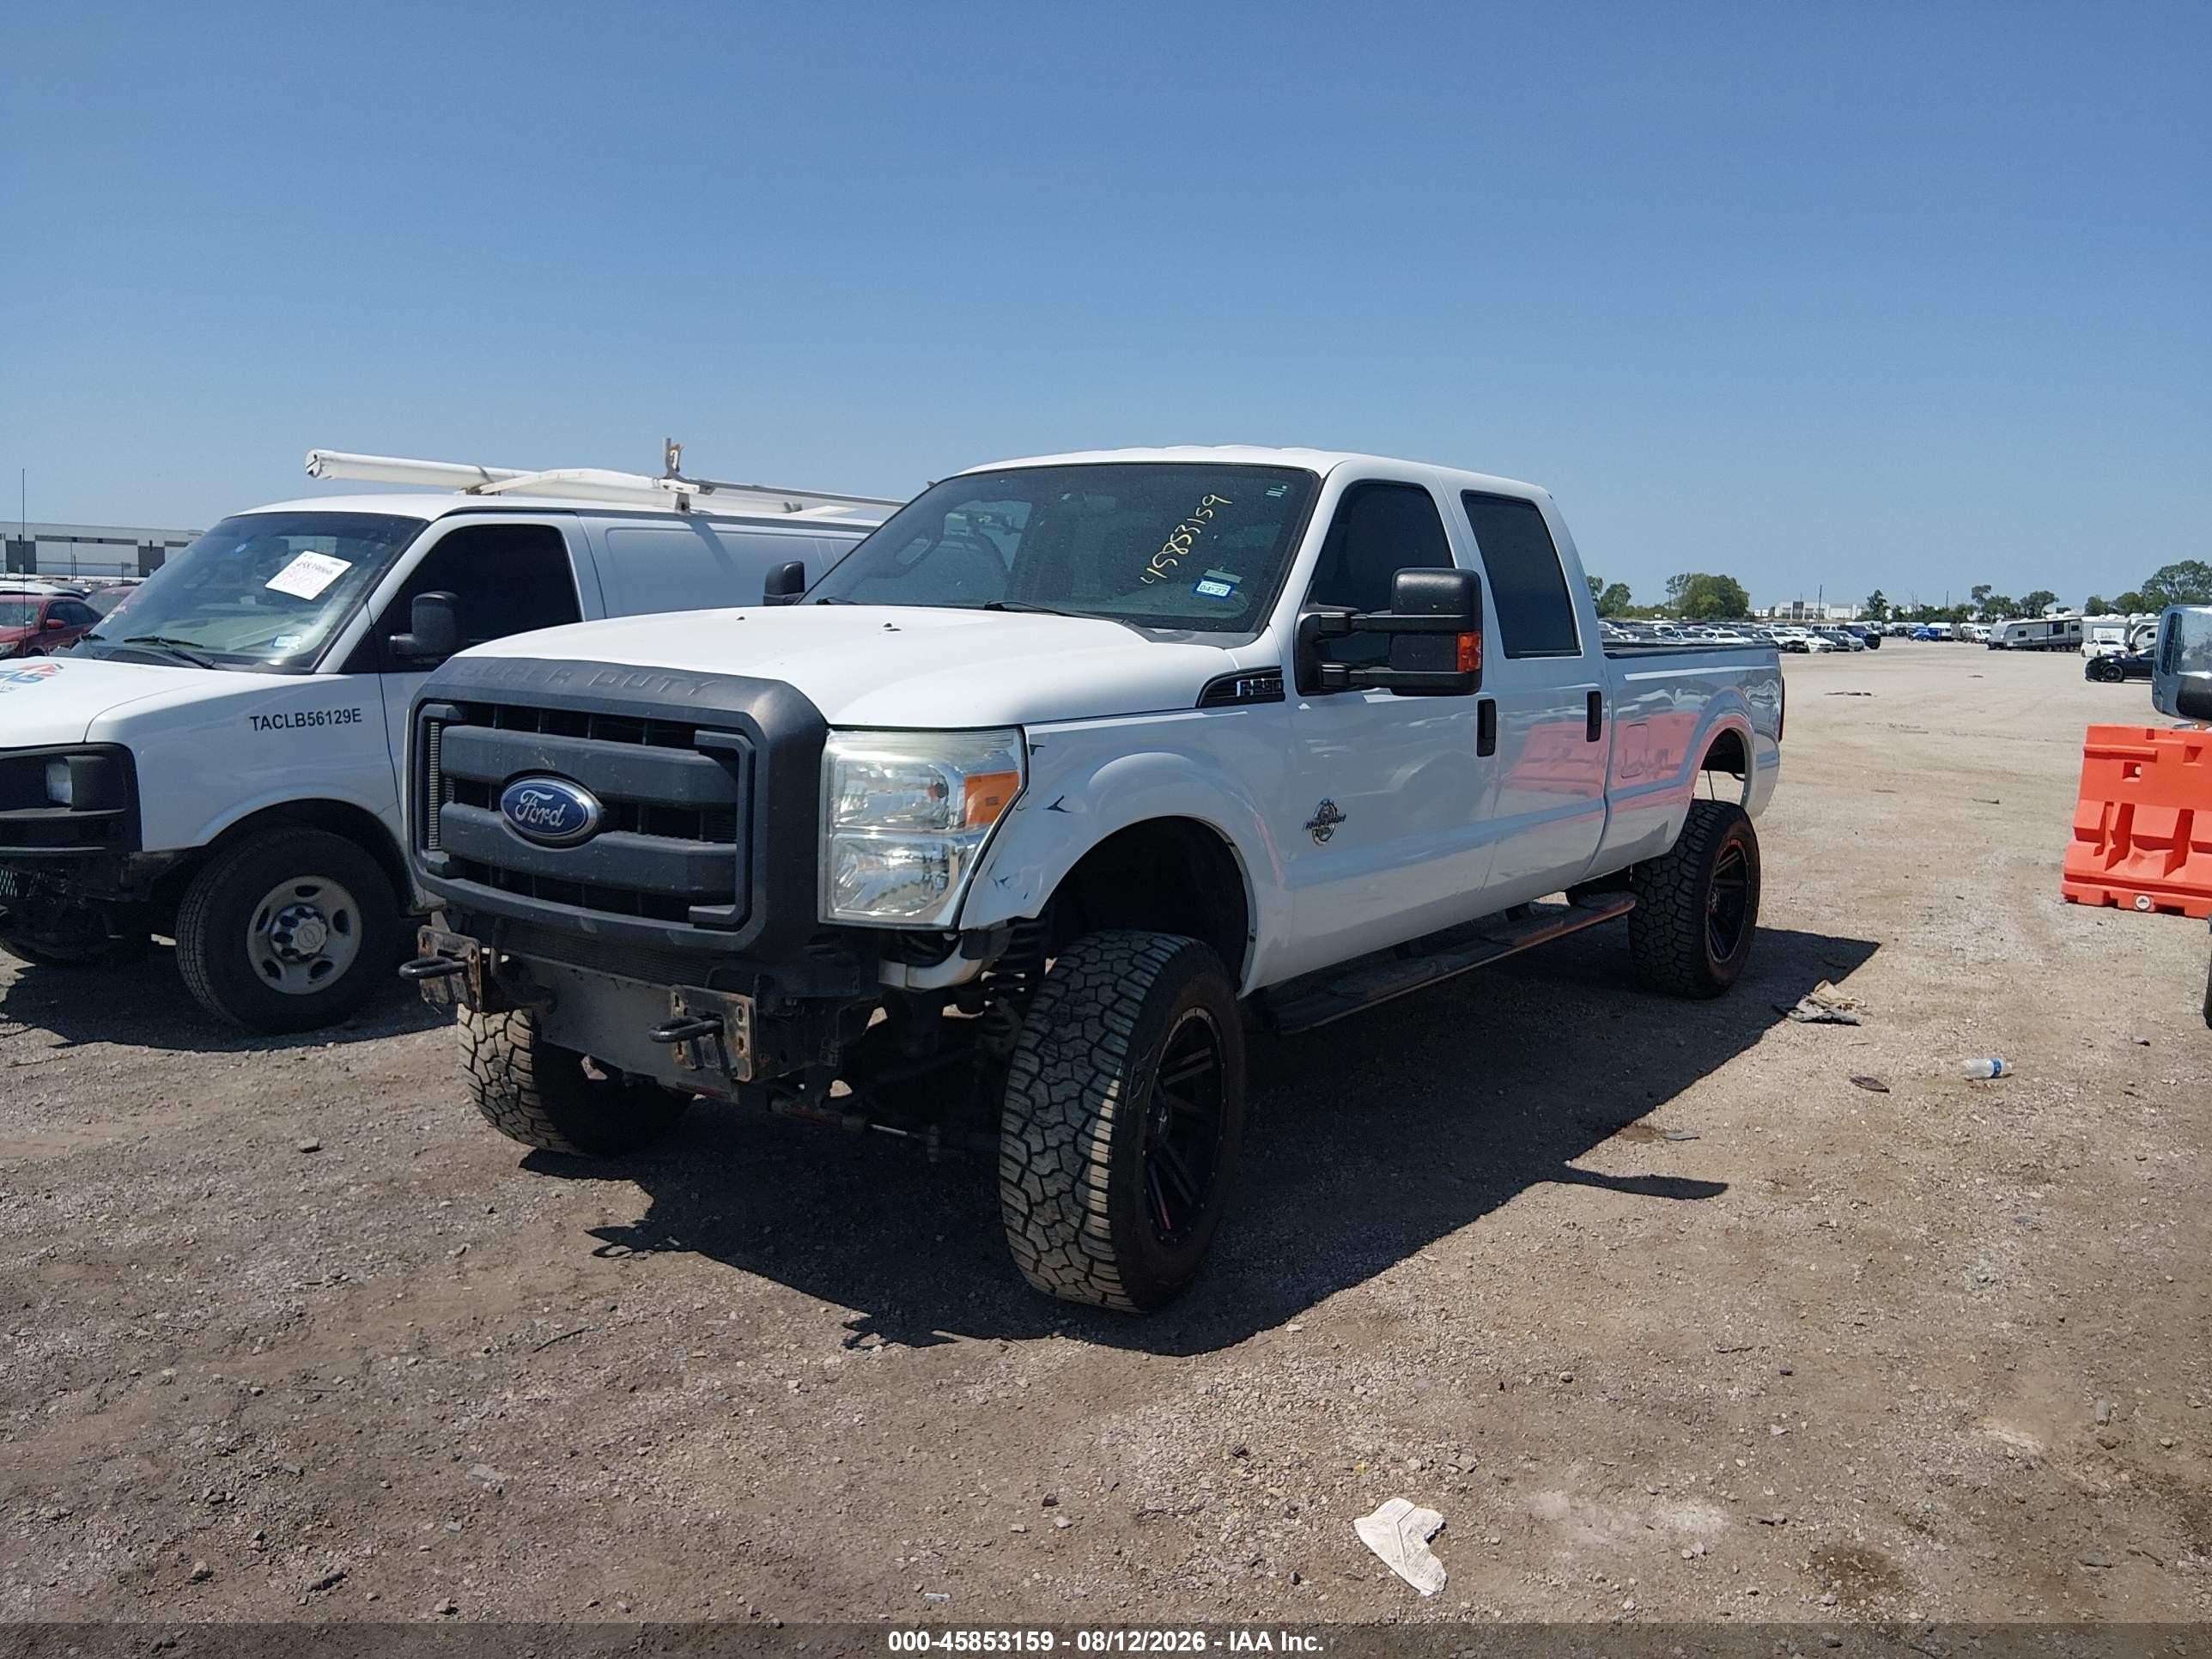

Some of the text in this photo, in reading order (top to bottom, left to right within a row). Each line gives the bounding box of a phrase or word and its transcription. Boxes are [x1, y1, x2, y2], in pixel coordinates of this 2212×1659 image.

[1139, 494, 1234, 584] 45853159
[587, 667, 720, 696] DUTY
[249, 708, 362, 731] TACLB56129E
[515, 789, 567, 827] Ford
